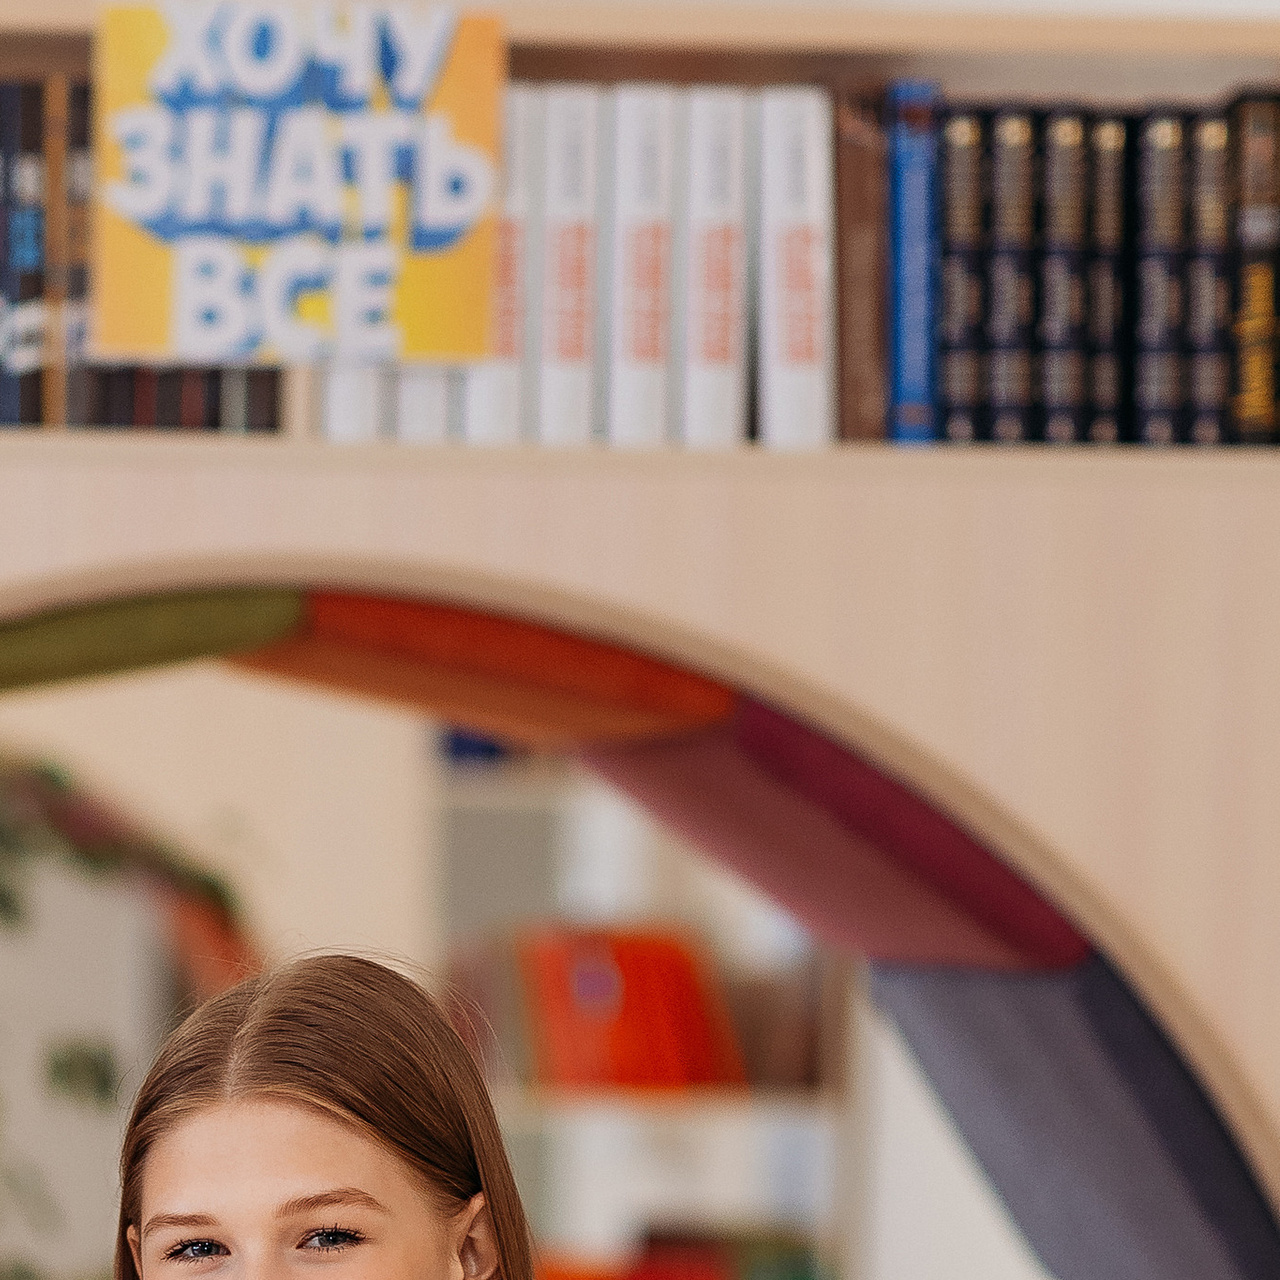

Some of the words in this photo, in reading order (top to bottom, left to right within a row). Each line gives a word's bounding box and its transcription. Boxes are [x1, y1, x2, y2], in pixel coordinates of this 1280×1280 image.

[150, 0, 458, 99] ХОЧУ
[106, 108, 494, 228] ЗНАТЬ
[170, 240, 402, 360] ВСЕ
